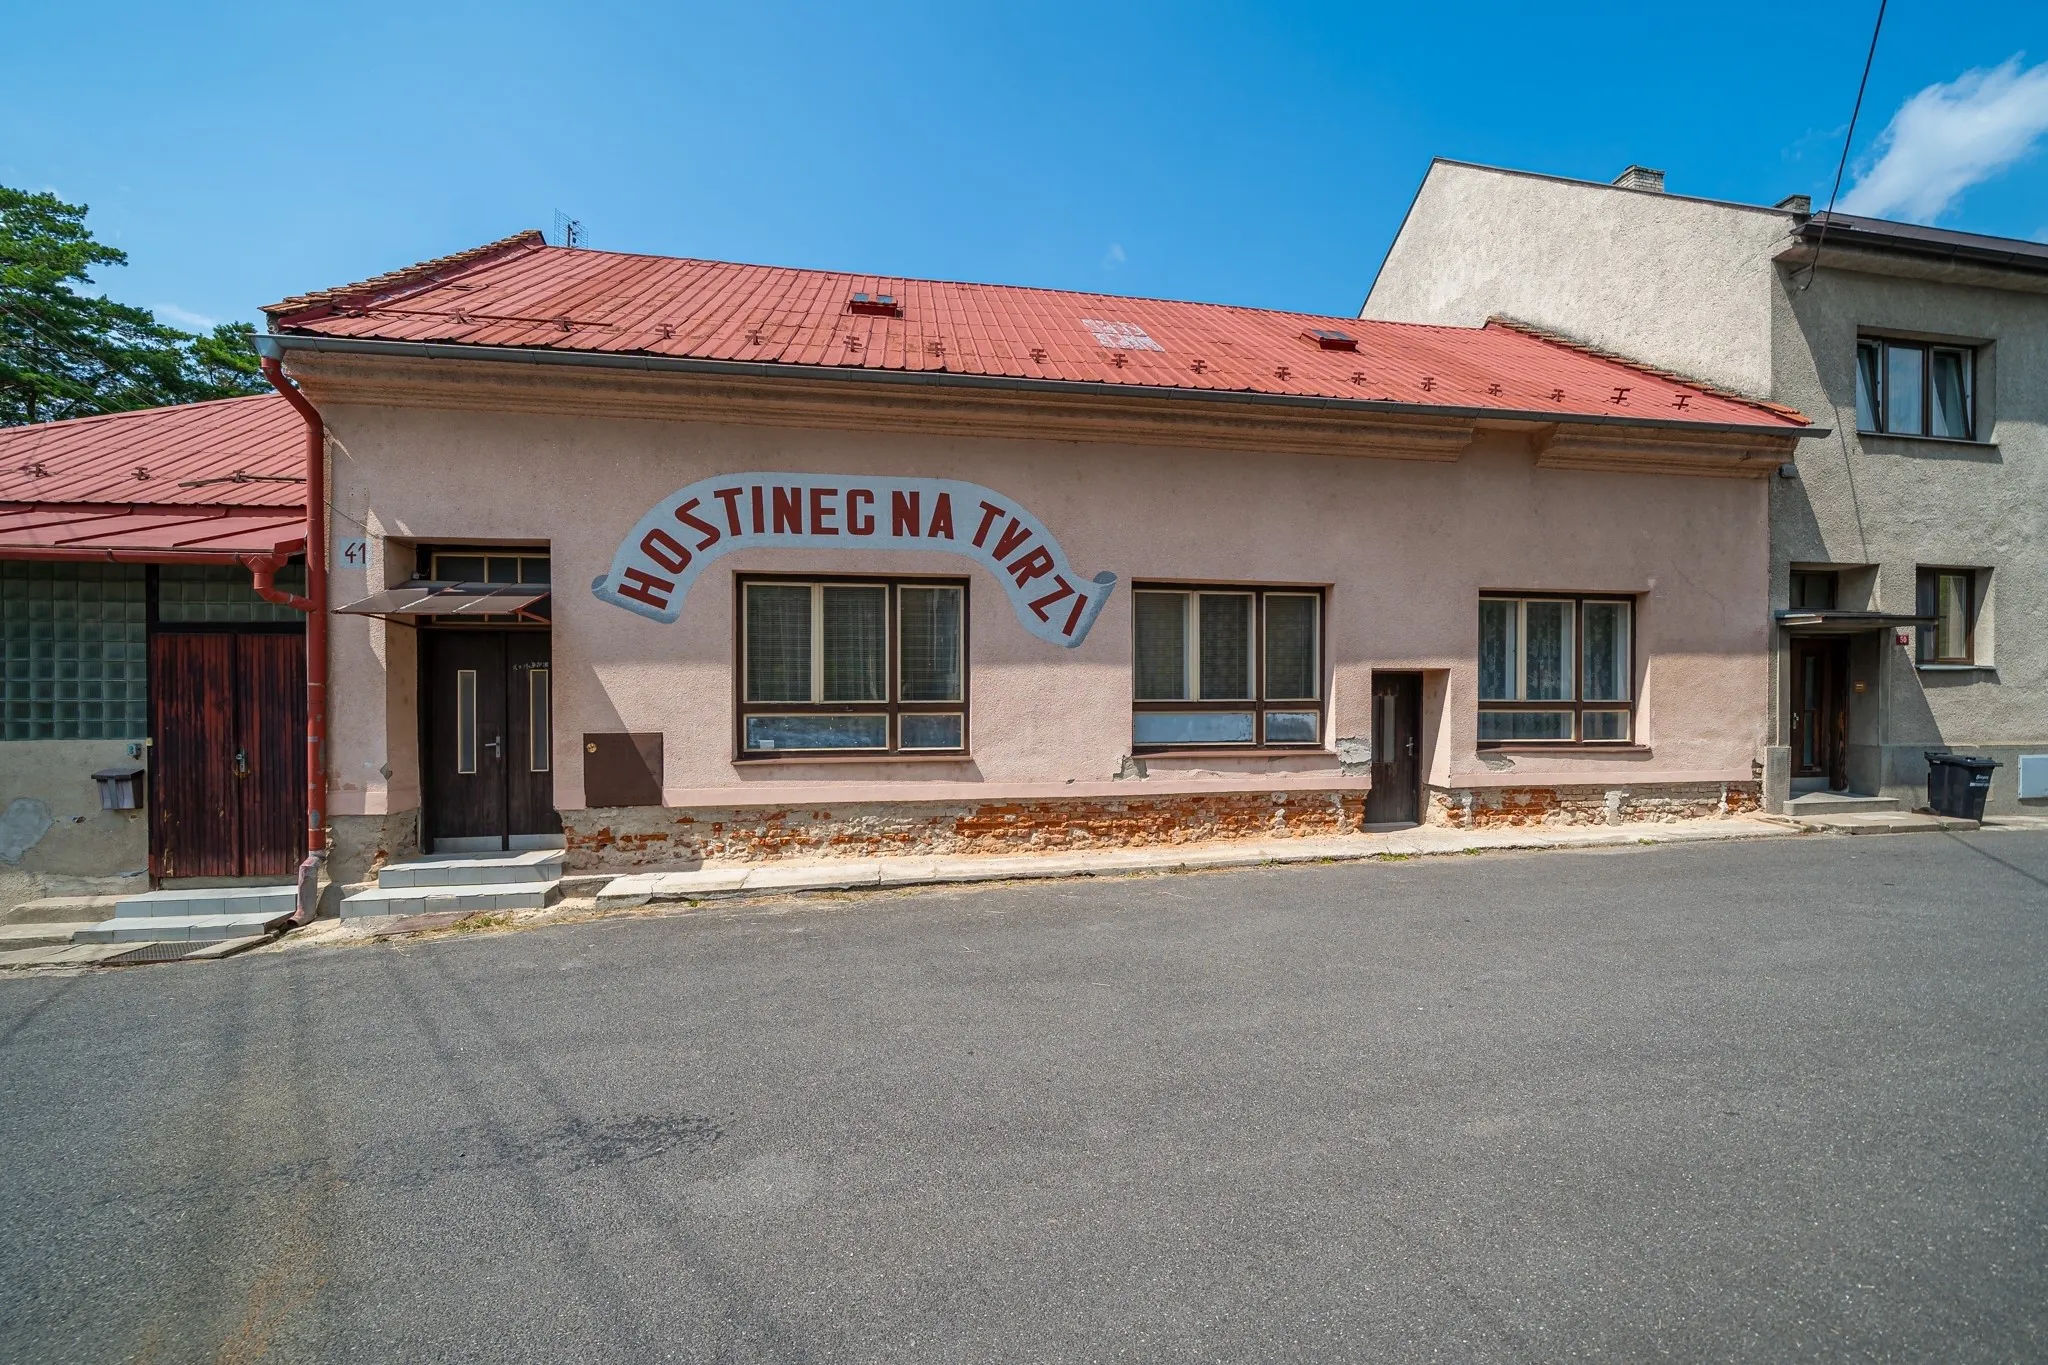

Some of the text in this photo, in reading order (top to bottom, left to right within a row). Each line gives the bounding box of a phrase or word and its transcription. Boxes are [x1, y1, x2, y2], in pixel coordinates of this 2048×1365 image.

[344, 542, 366, 564] 41
[617, 486, 1089, 637] HOSTINEC NA TVRZI
